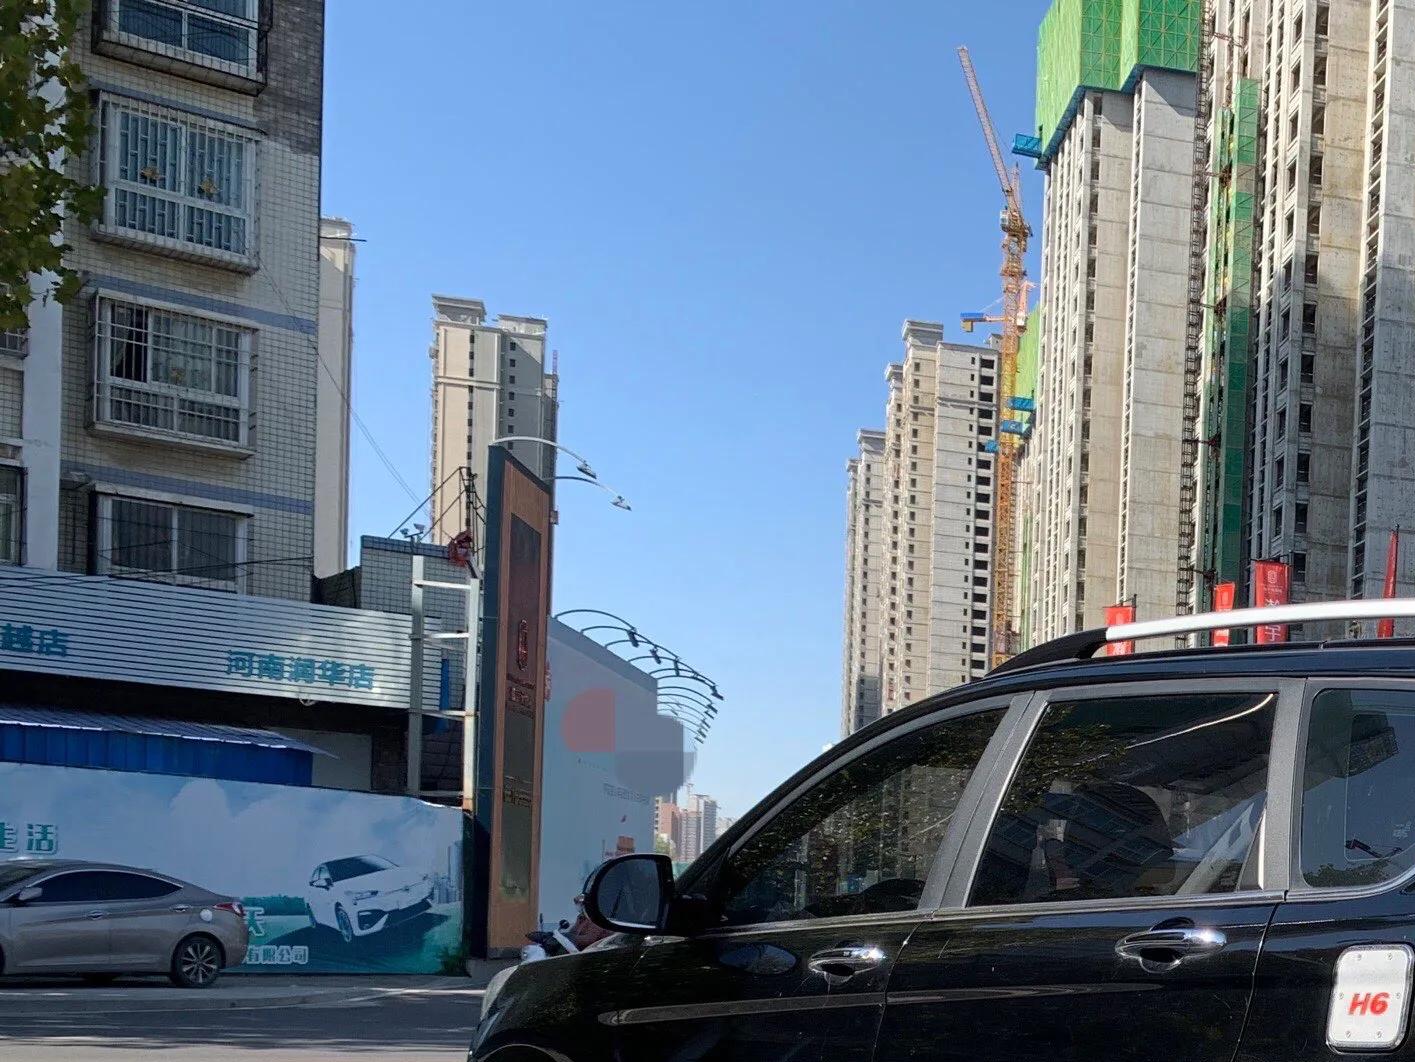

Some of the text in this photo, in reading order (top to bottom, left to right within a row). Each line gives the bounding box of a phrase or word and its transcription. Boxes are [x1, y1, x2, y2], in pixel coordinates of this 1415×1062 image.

[226, 650, 375, 690] 河南润华店
[1348, 991, 1391, 1016] H6
